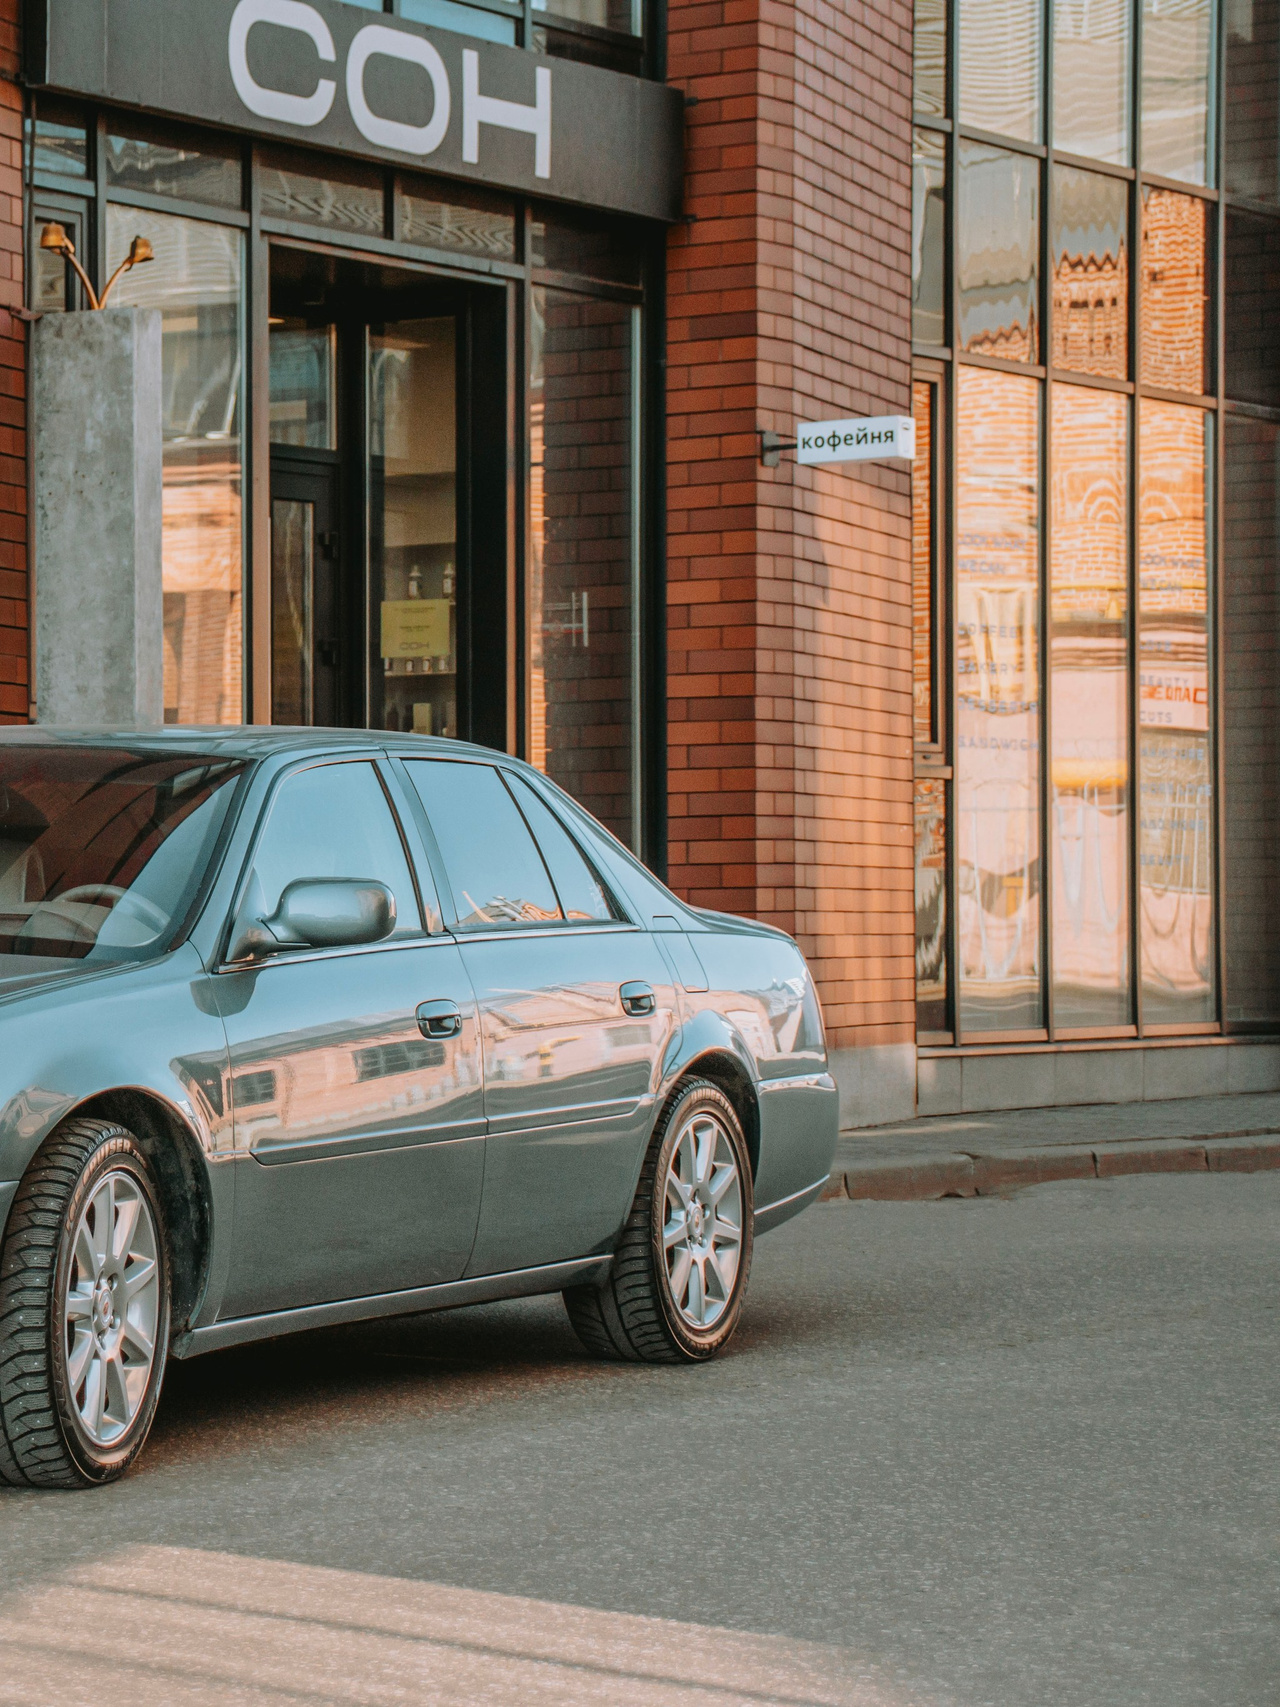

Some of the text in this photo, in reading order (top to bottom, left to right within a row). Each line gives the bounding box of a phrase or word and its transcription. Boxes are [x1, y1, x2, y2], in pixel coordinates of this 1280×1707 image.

[228, 0, 551, 179] СОН
[802, 427, 894, 452] кофейня
[958, 622, 1017, 639] COFFEE
[958, 659, 1018, 675] BAKERY
[1140, 675, 1190, 688] BEAUTY
[82, 1138, 131, 1186] CRUISER
